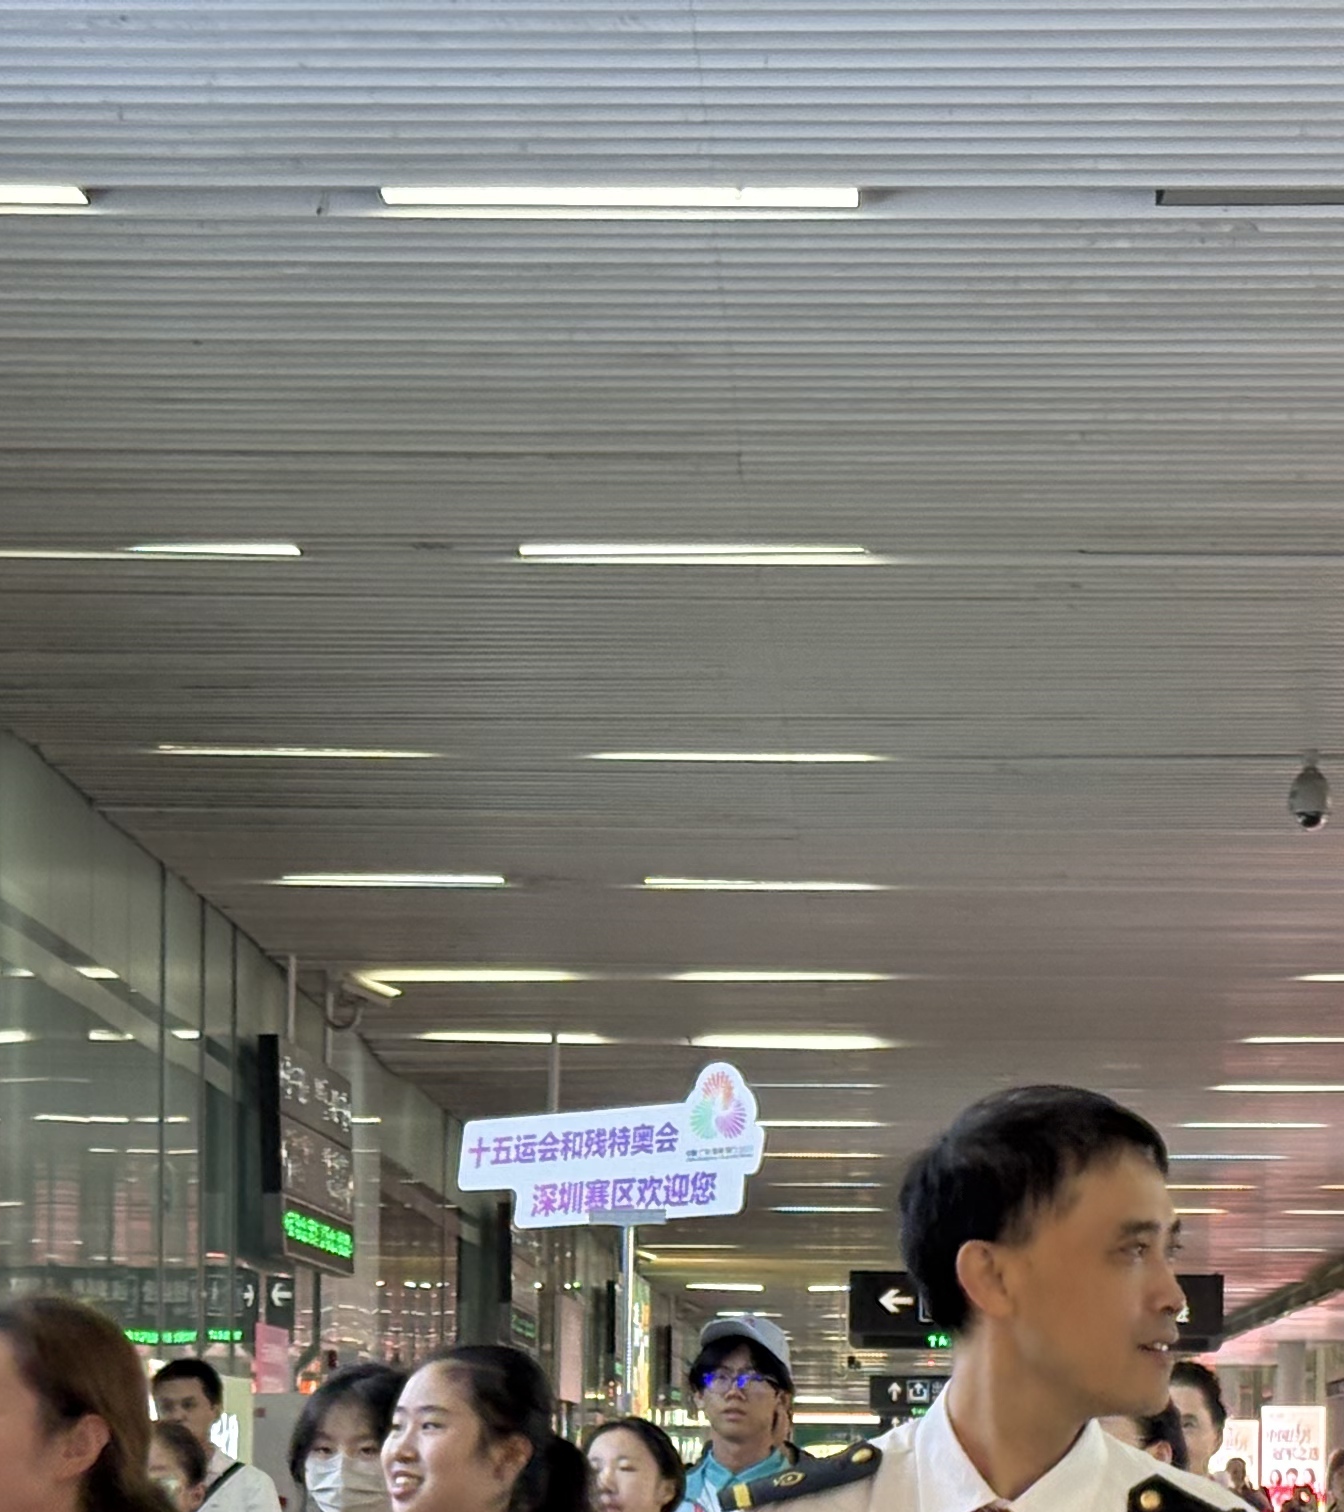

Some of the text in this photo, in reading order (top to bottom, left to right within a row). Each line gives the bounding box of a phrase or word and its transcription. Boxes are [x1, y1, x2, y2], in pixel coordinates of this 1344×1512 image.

[468, 1121, 679, 1168] 十五运会和残特奥会
[531, 1171, 717, 1217] 深圳赛区欢迎您
